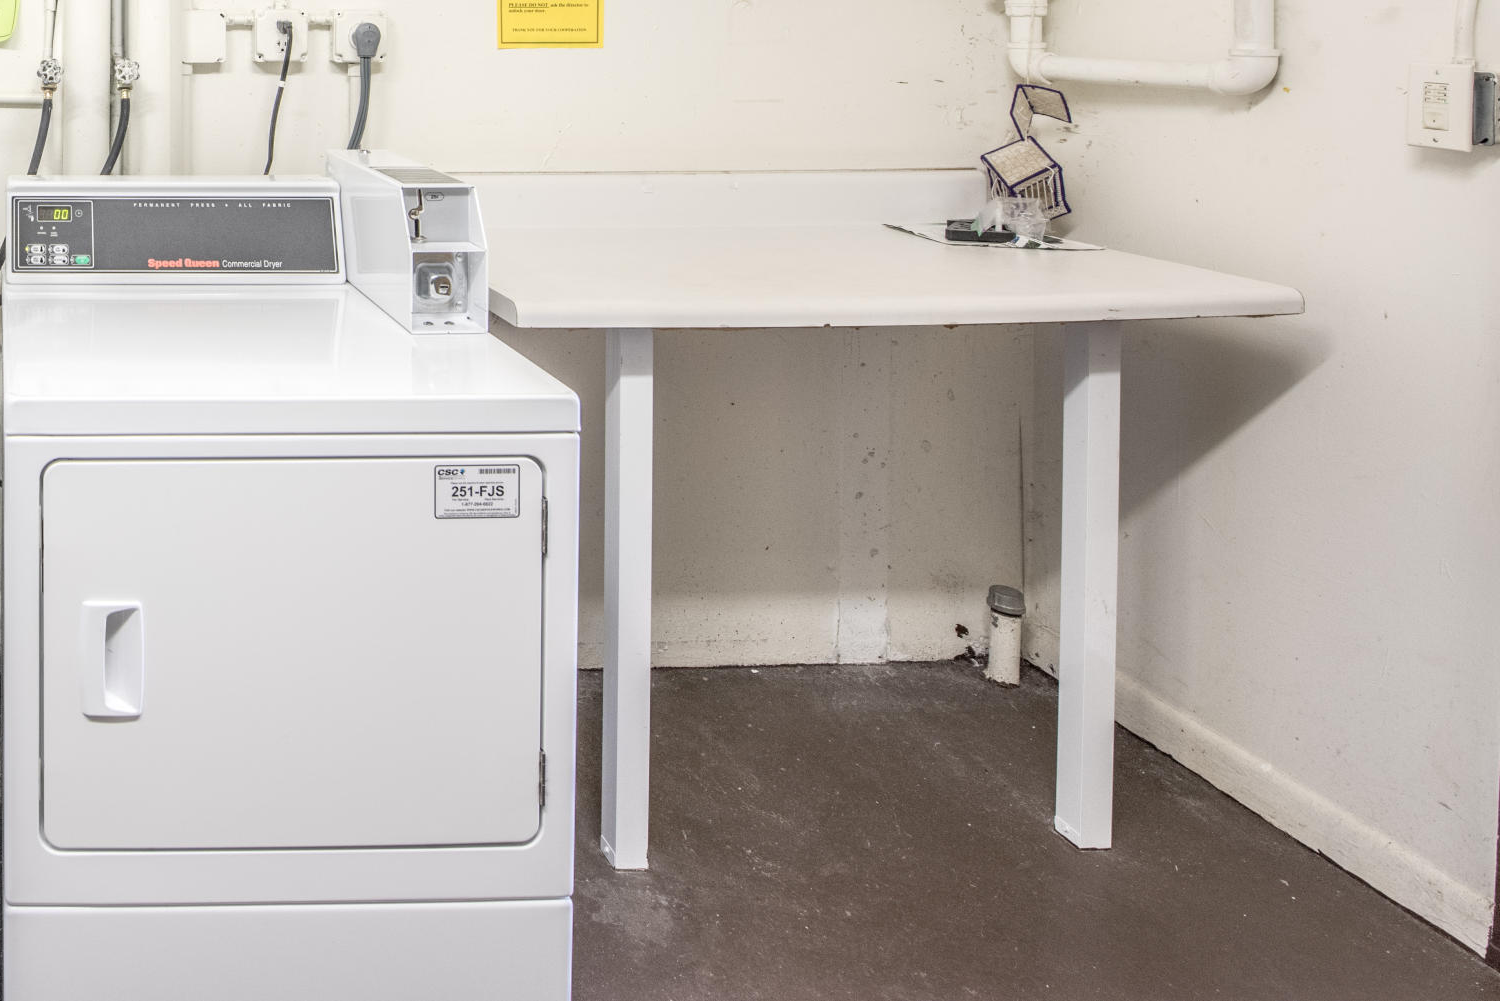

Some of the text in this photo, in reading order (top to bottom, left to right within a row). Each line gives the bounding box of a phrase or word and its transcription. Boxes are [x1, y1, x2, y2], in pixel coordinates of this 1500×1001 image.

[53, 209, 69, 220] 00
[147, 258, 283, 270] Speed Queen Commercial Dryer
[451, 485, 505, 497] 251-FJS
